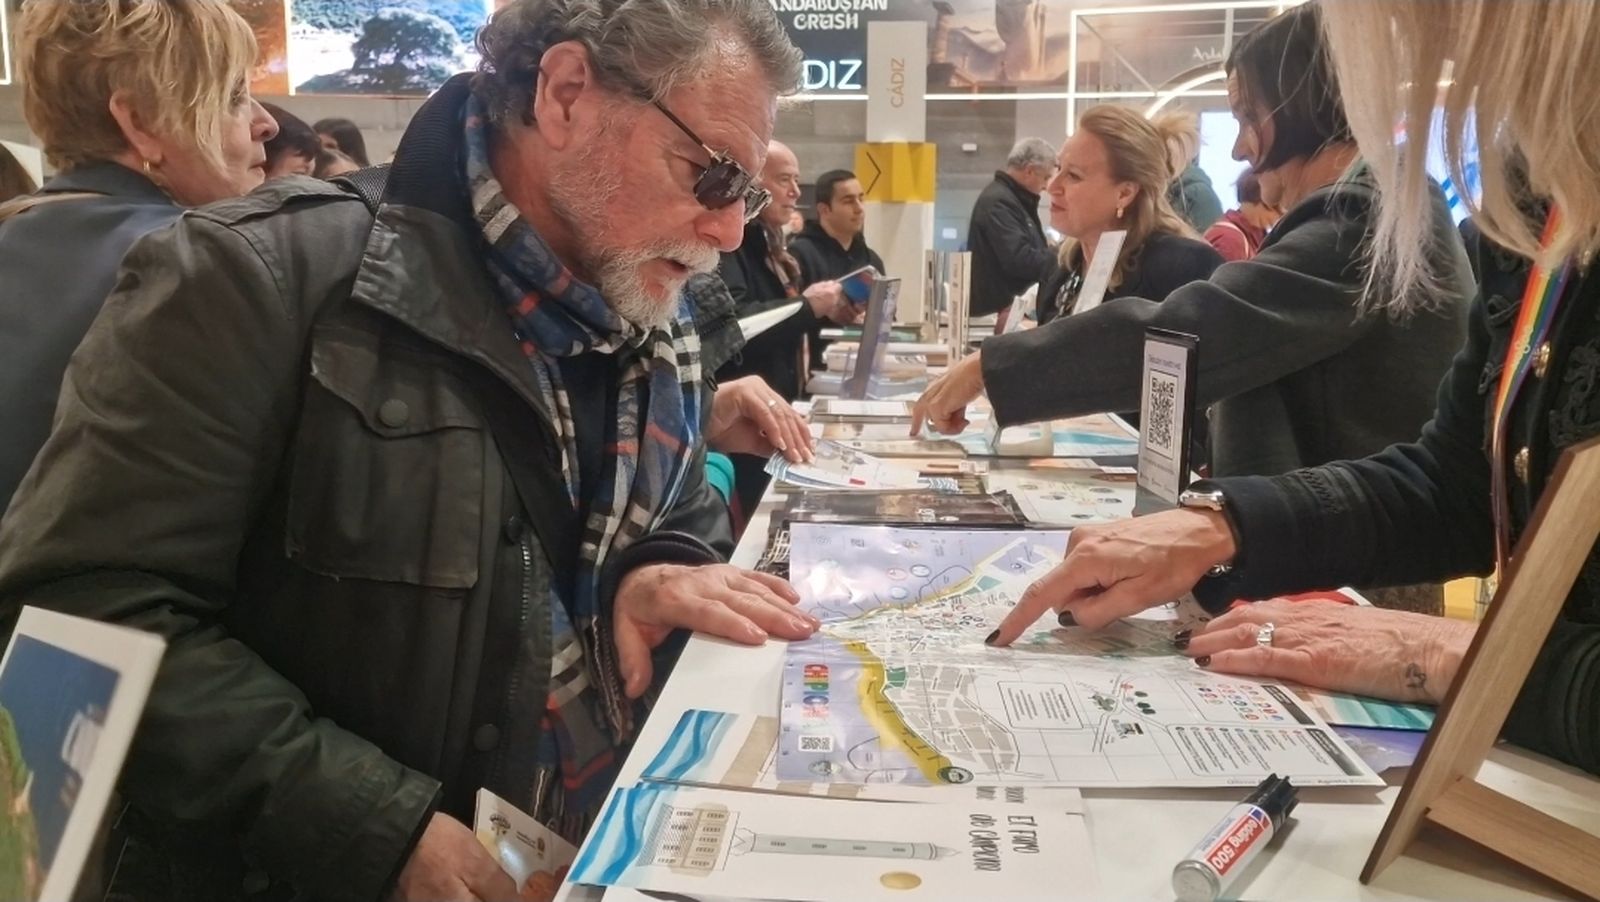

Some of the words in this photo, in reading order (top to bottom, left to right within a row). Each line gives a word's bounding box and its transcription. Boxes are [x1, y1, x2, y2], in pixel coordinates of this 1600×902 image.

[793, 13, 859, 30] CRUSH
[802, 59, 862, 90] DIZ
[886, 57, 905, 108] CÁDIZ
[1228, 818, 1258, 848] edding
[1211, 844, 1236, 870] 500
